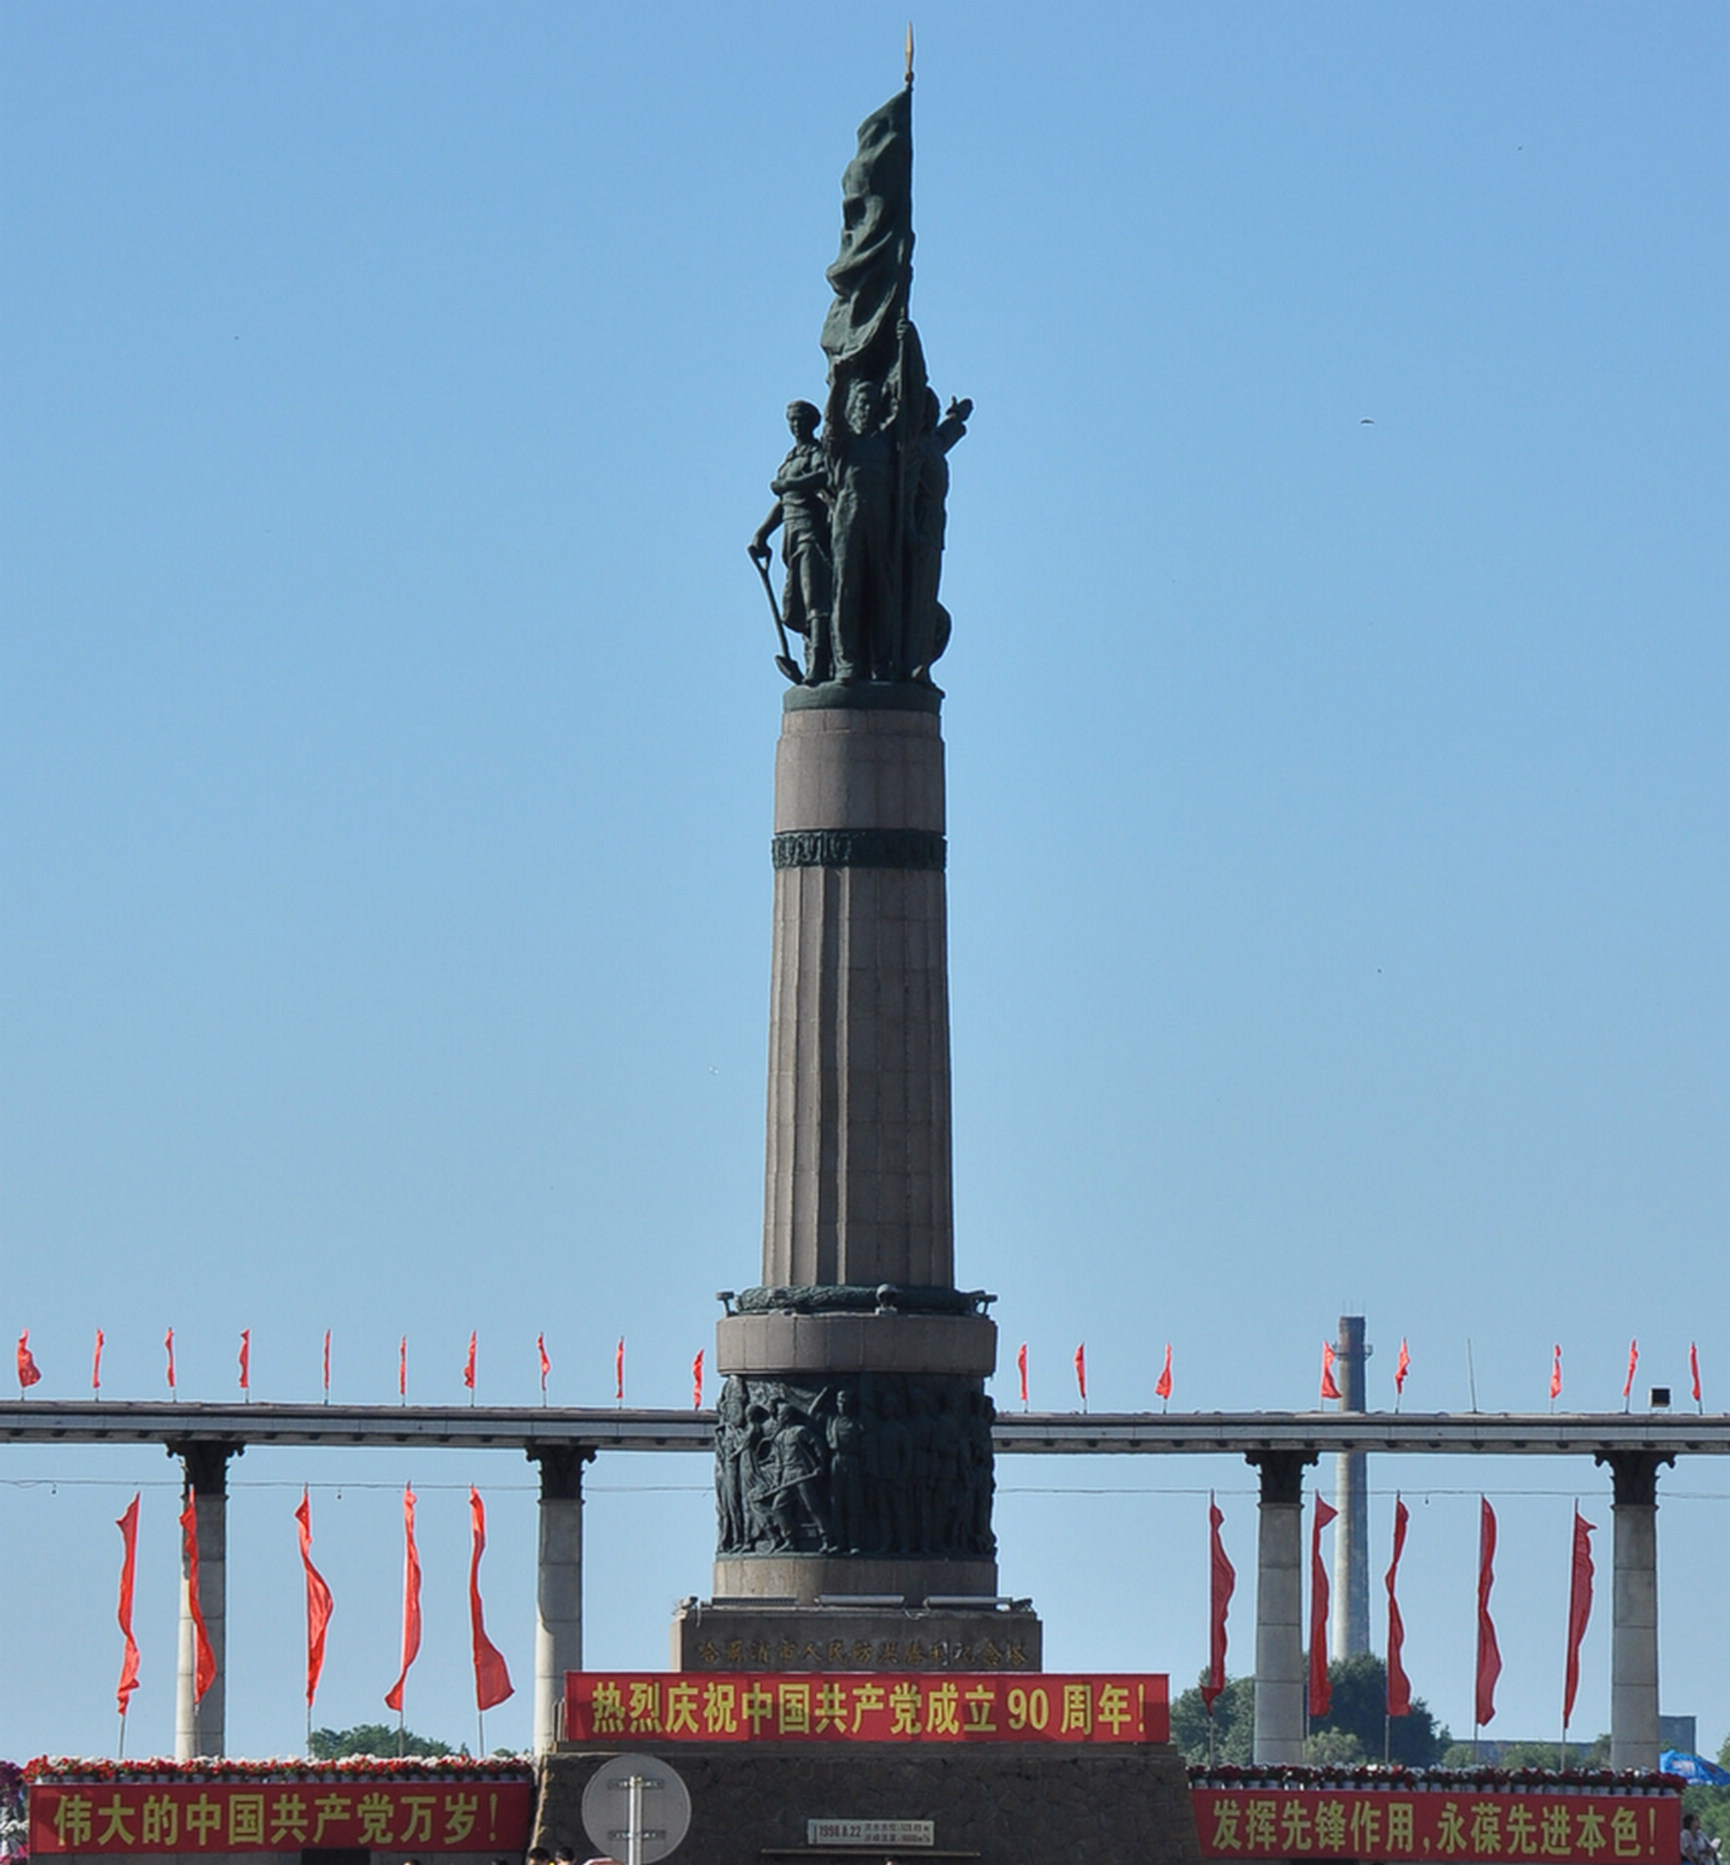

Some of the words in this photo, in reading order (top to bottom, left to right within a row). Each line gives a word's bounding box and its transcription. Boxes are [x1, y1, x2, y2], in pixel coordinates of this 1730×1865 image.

[592, 1681, 1145, 1735] 热烈庆祝中国共产党成立90周年!
[54, 1793, 498, 1846] 伟大的中国共产党万岁!
[1211, 1799, 1656, 1857] 发挥先锋作用,永葆先进本色!
